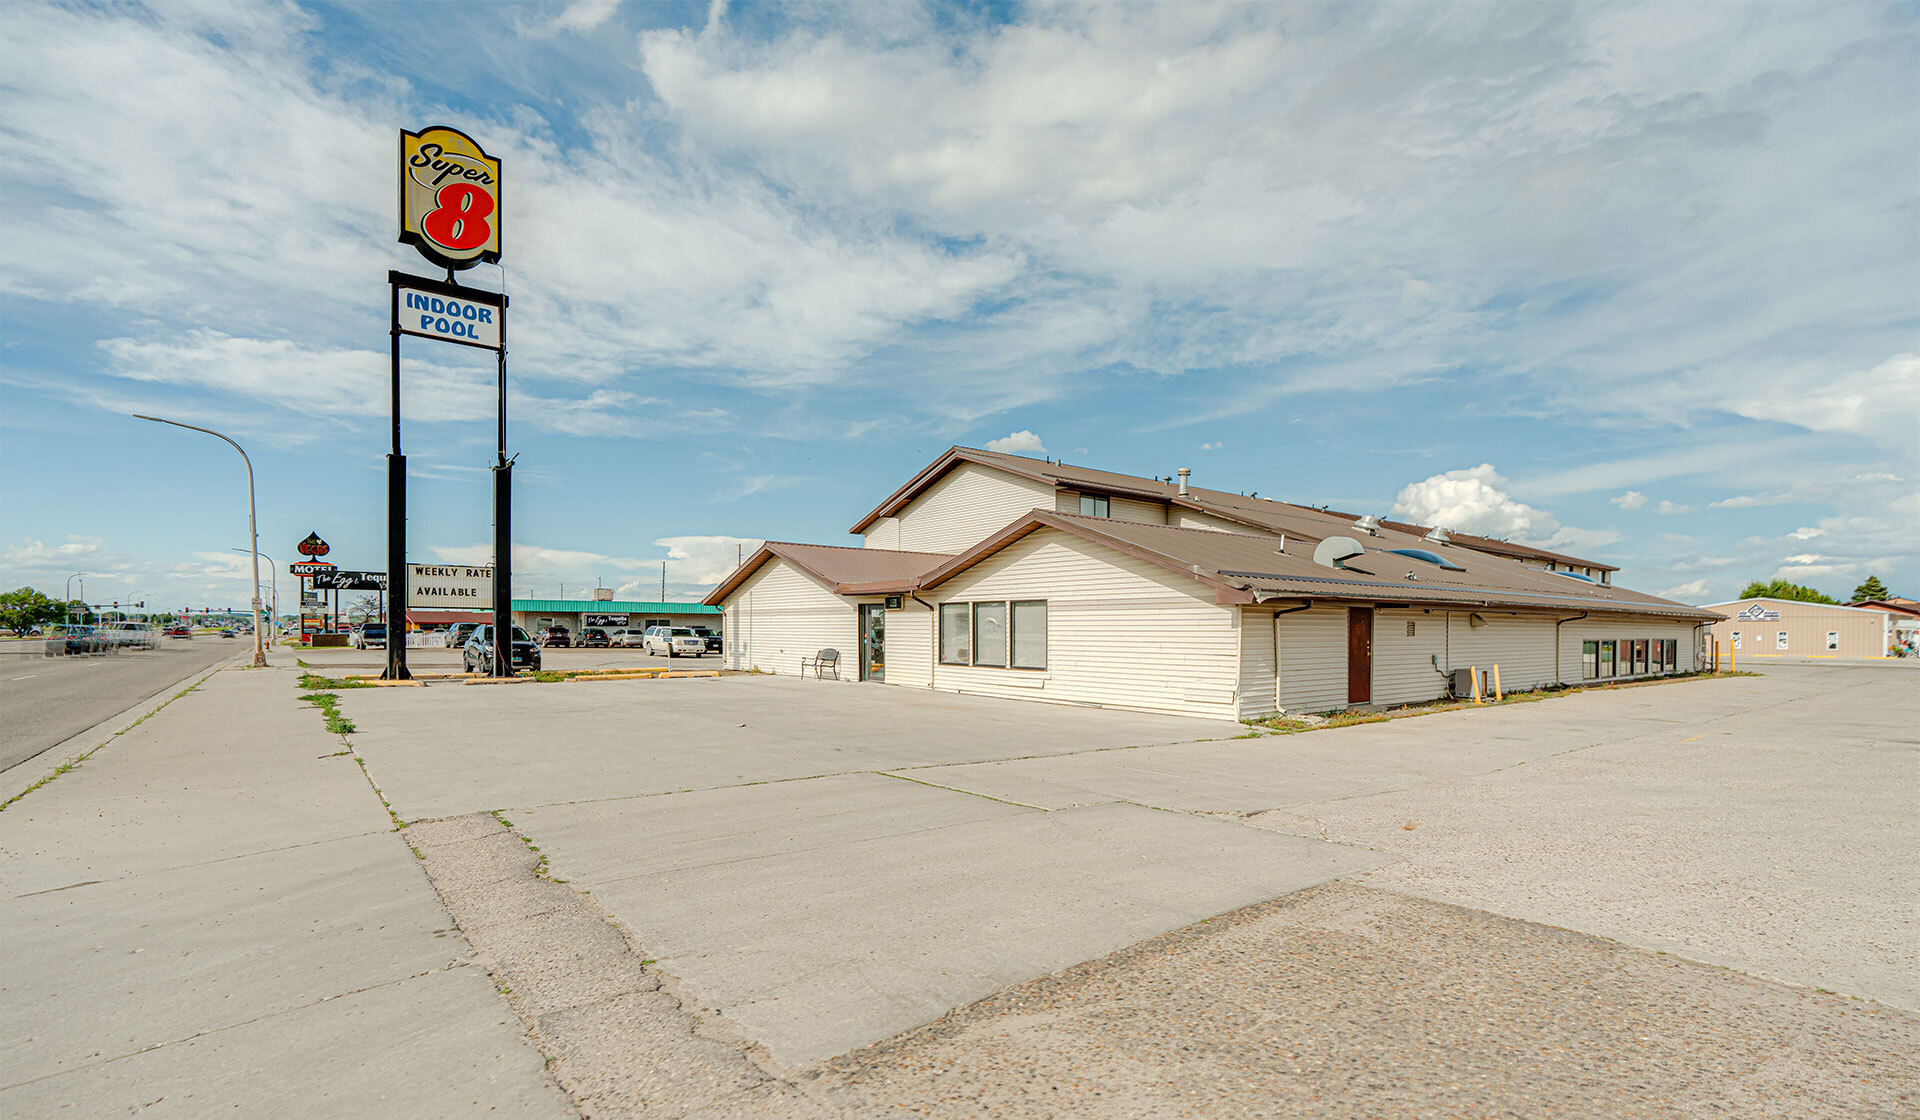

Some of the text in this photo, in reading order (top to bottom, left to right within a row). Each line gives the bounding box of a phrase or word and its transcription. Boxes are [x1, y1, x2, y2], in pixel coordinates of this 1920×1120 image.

[408, 143, 494, 186] Super
[421, 182, 495, 251] 8
[406, 292, 492, 324] INDOOR
[420, 314, 479, 340] POOL
[316, 574, 331, 585] The
[332, 572, 353, 588] Egg
[359, 573, 386, 583] Tequ
[415, 567, 491, 578] WEEKLY RATE
[416, 587, 477, 597] AVAILABLE
